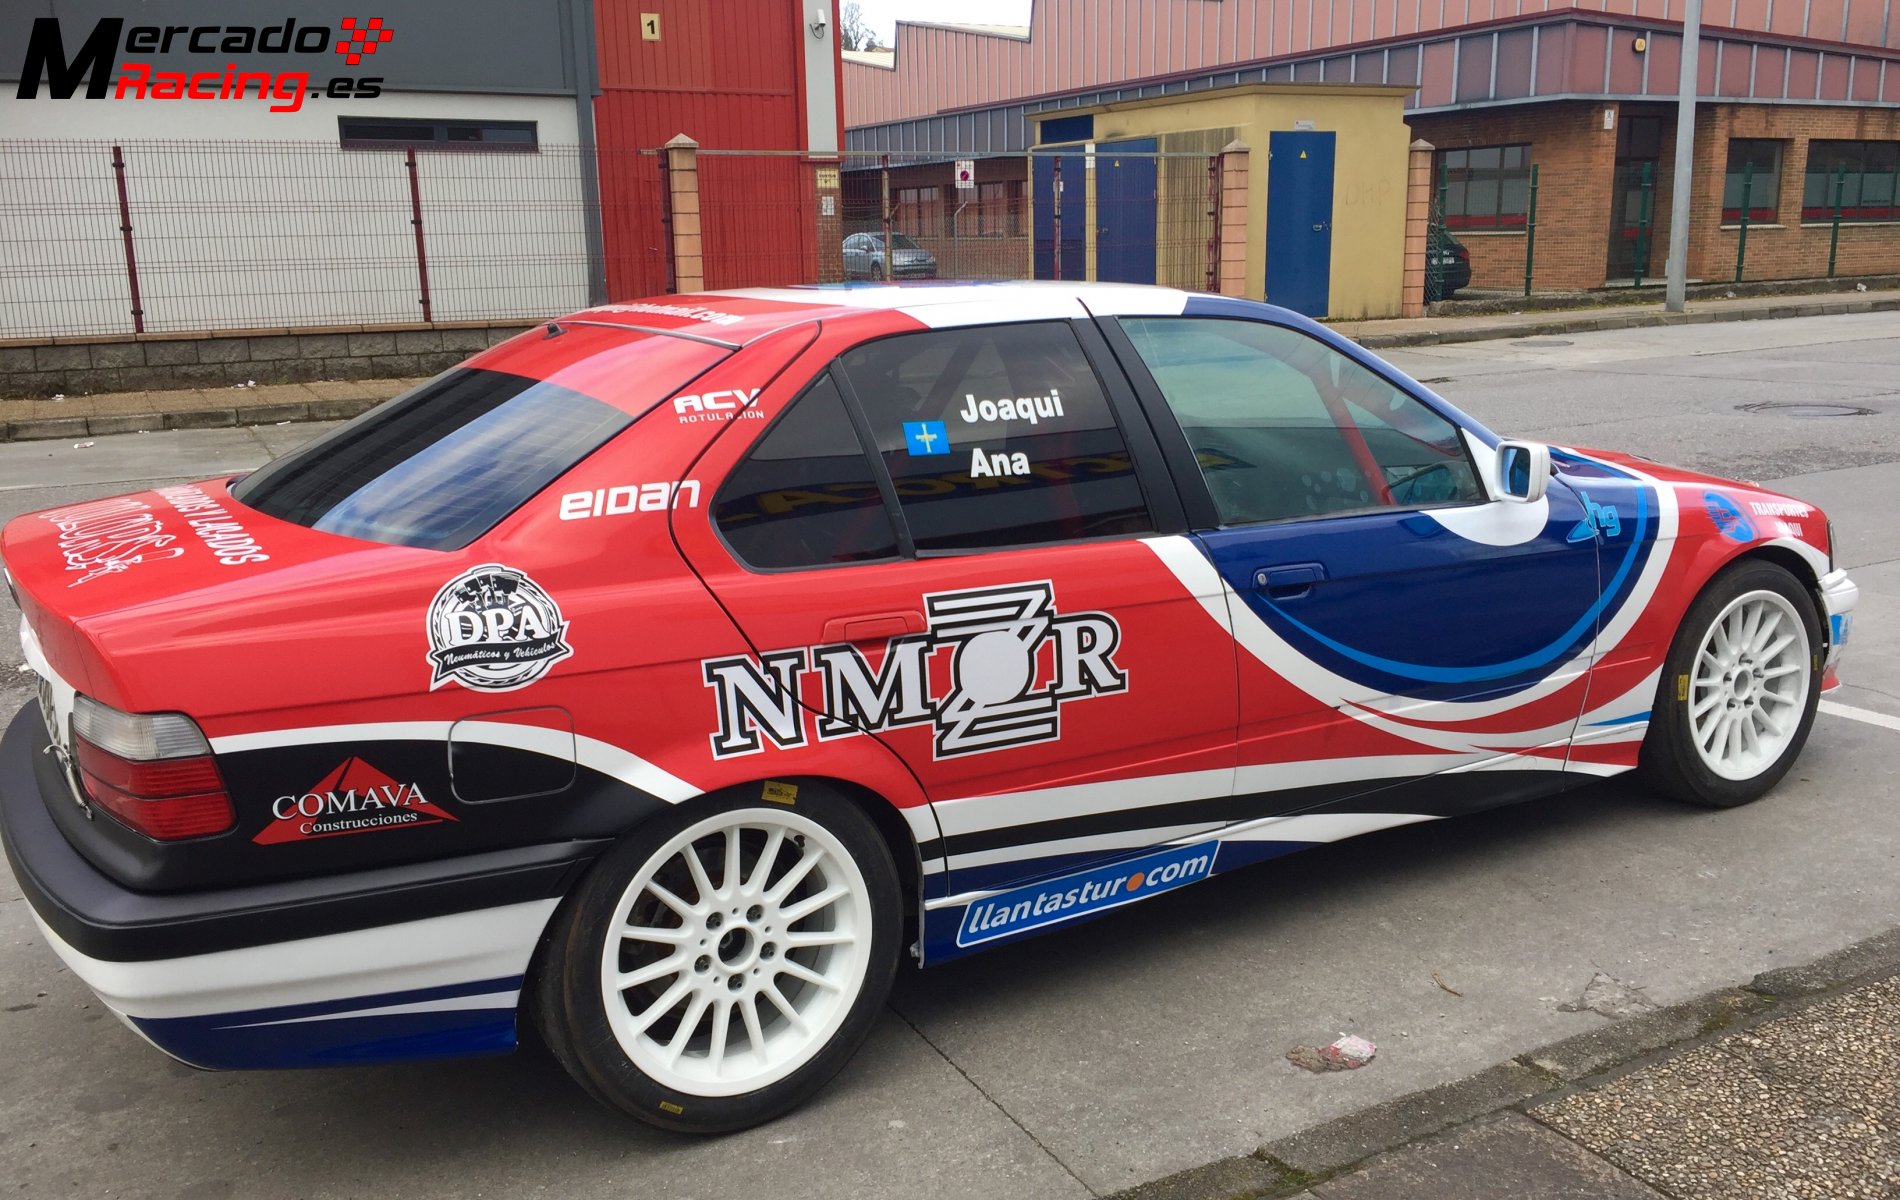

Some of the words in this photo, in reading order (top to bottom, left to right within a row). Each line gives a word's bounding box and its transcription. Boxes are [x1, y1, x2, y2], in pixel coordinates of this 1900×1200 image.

[646, 20, 655, 35] 1
[673, 388, 761, 414] ACV
[960, 389, 1065, 424] Joaqui
[970, 447, 1031, 478] Ana
[444, 605, 552, 647] DPA
[443, 650, 501, 666] Neumáticos
[503, 651, 511, 661] y
[272, 782, 429, 820] COMAVA
[300, 812, 418, 834] Construcciones
[967, 855, 1209, 934] llantastur.com
